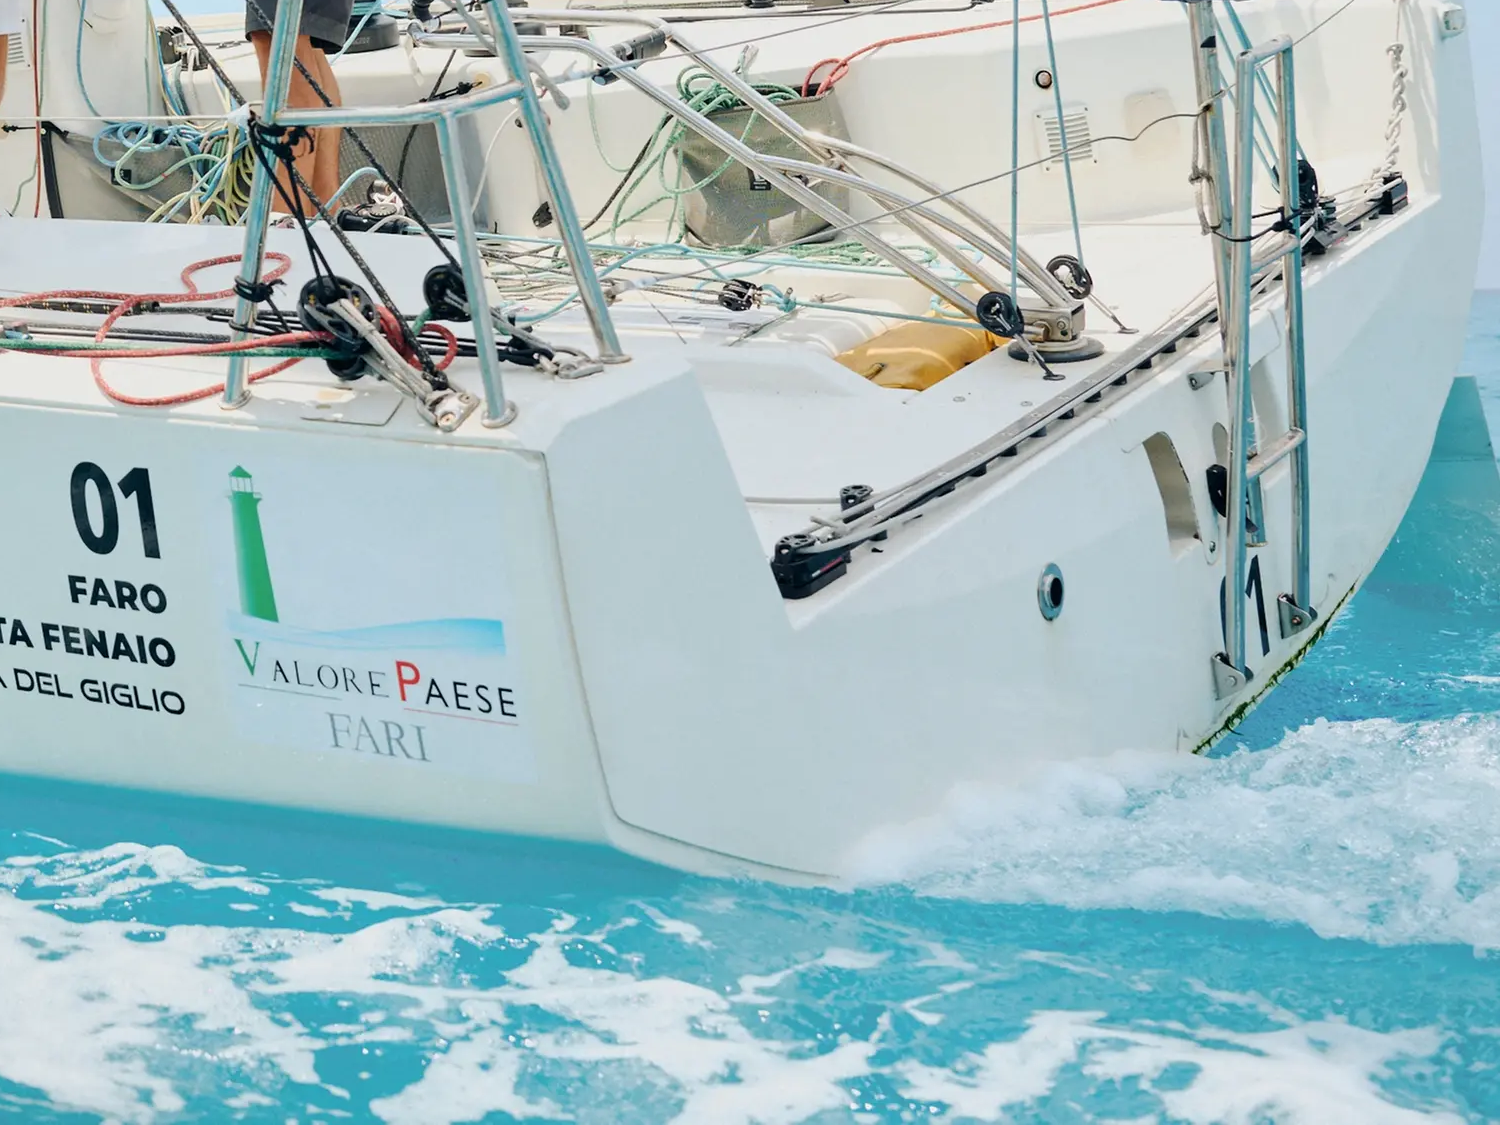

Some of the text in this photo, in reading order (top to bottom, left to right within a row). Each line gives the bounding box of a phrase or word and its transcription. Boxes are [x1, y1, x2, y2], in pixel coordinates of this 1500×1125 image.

[70, 461, 161, 560] 01
[68, 574, 168, 615] FARO
[42, 622, 176, 668] FENAIO
[13, 668, 73, 699] DEL
[82, 680, 186, 716] GIGLIO
[328, 711, 433, 764] FARI
